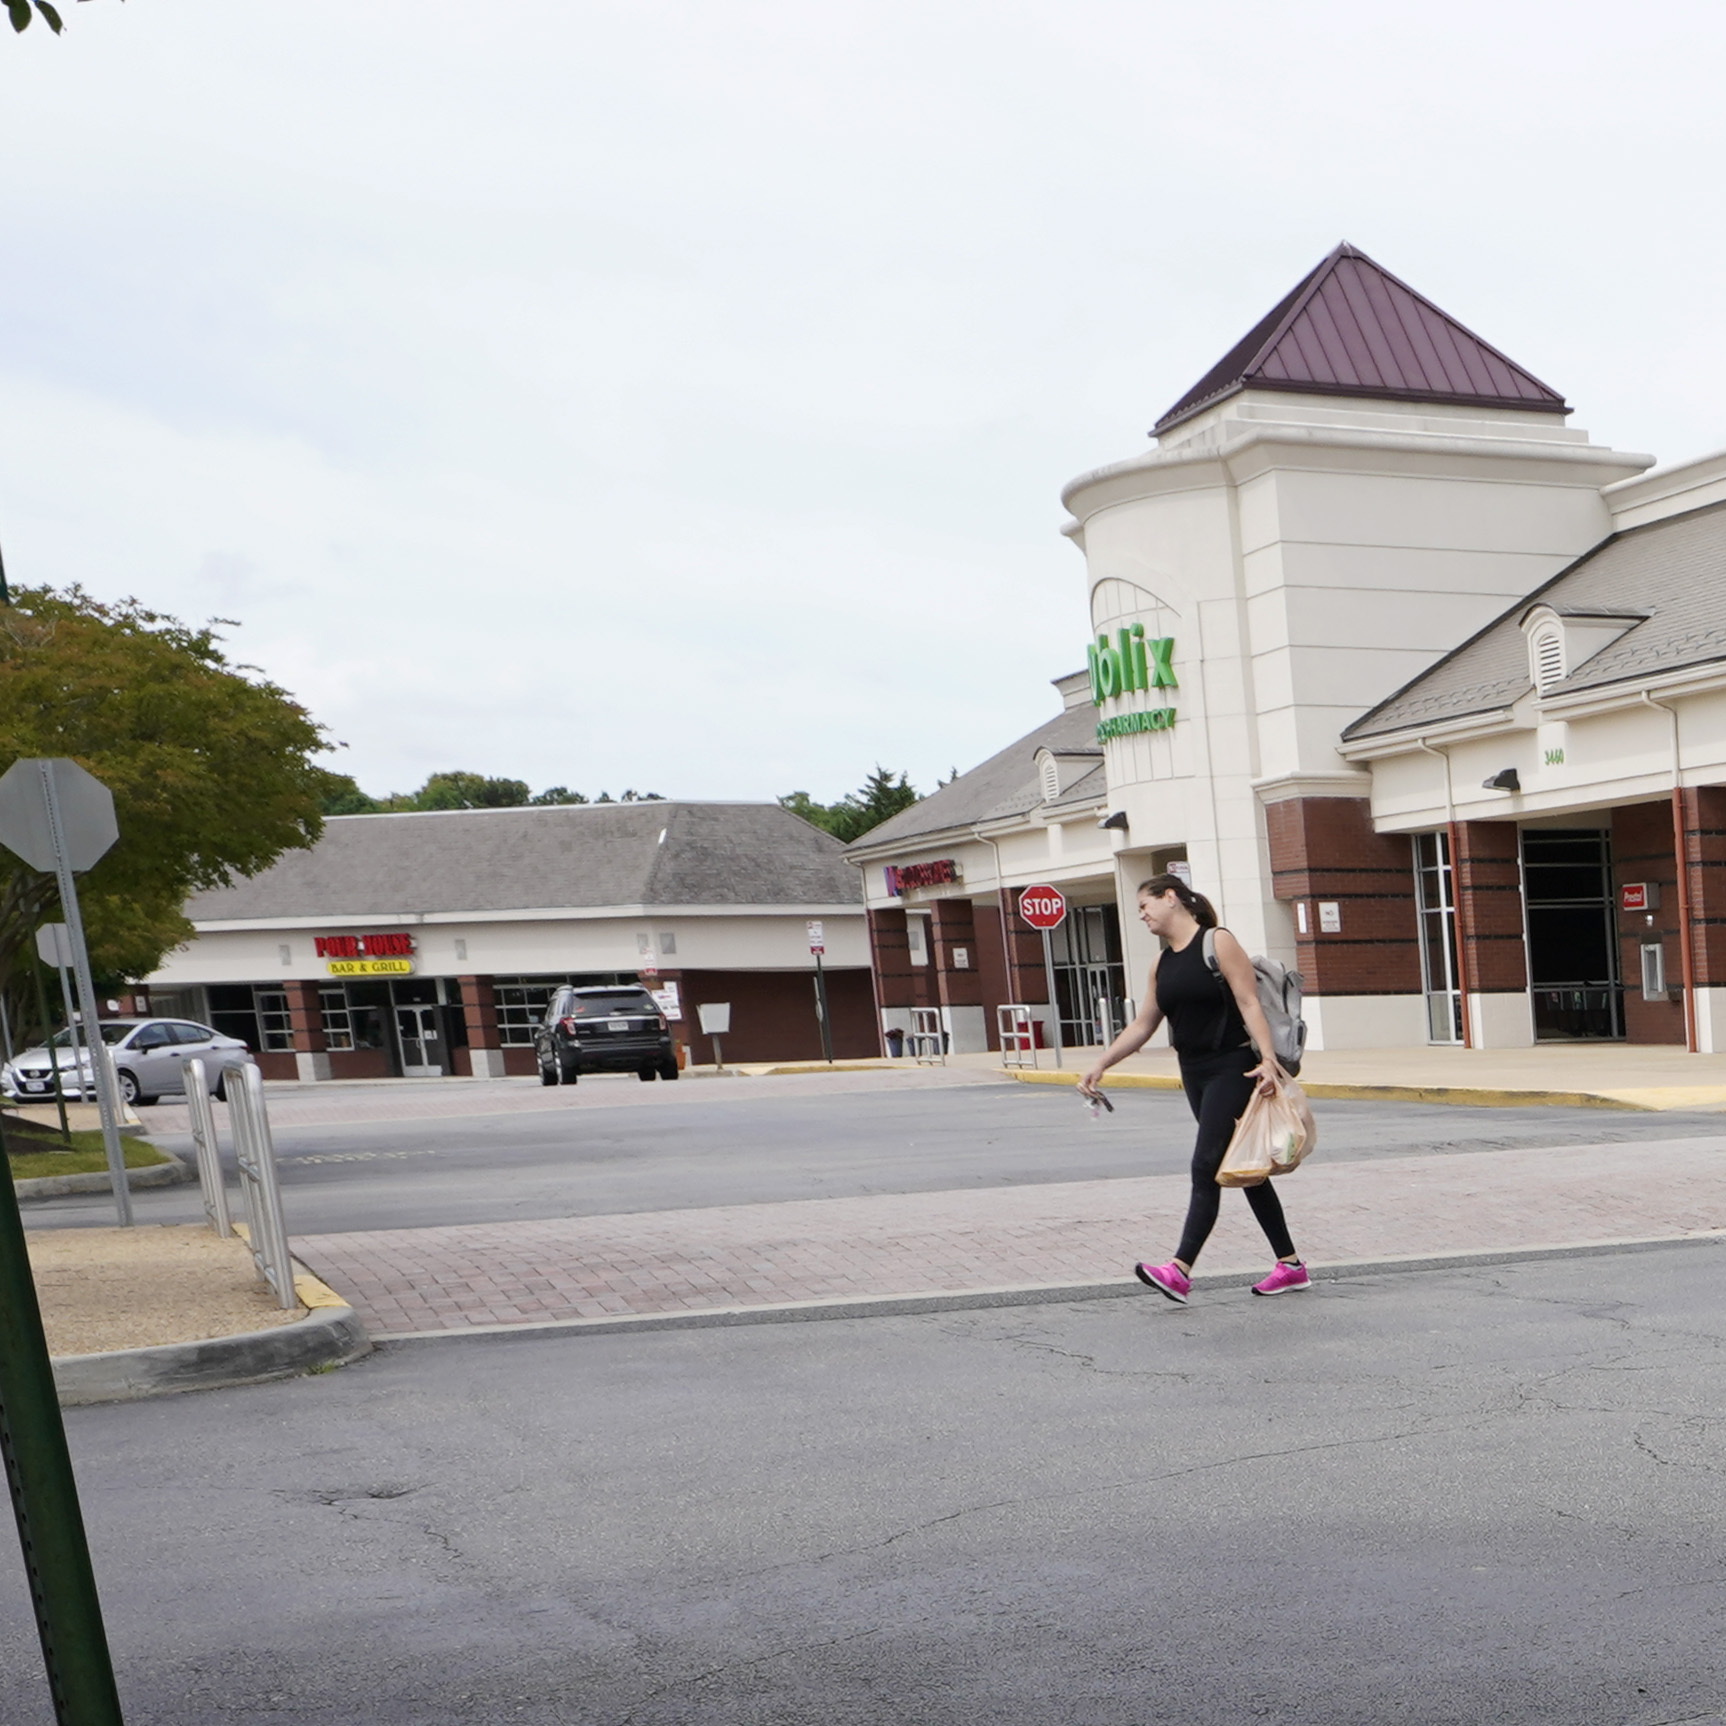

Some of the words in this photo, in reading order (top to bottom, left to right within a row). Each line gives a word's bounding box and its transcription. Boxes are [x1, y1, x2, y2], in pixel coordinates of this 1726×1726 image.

[1088, 622, 1178, 707] ublix
[1104, 707, 1176, 740] PHARMACY
[1023, 898, 1062, 916] STOP
[314, 935, 358, 957] POUR
[361, 933, 414, 956] HOUSE
[331, 963, 355, 974] BAR
[360, 963, 367, 972] &
[371, 961, 407, 972] GRILL
